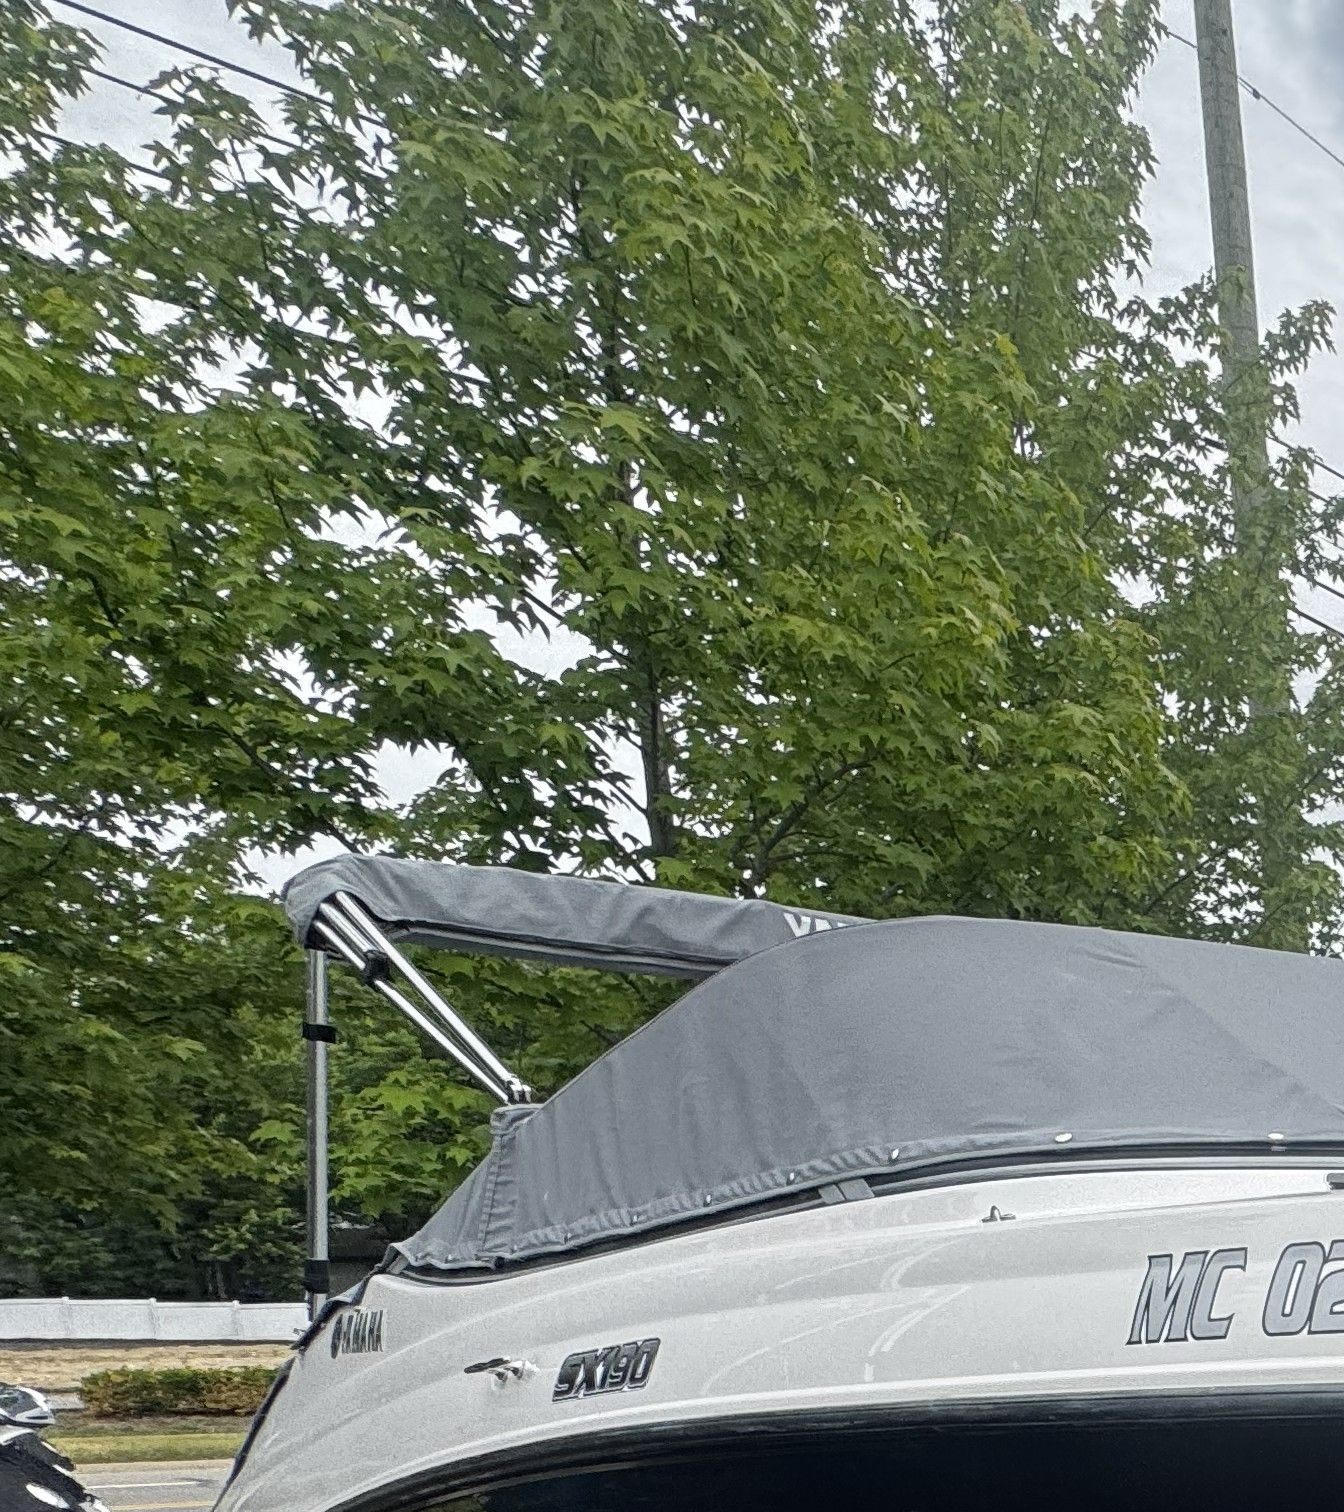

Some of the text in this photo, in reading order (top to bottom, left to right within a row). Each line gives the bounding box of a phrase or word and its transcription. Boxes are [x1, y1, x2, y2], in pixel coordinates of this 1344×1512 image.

[1126, 1246, 1247, 1347] MC
[341, 1310, 384, 1354] AMAHA
[552, 1337, 661, 1402] SX190
